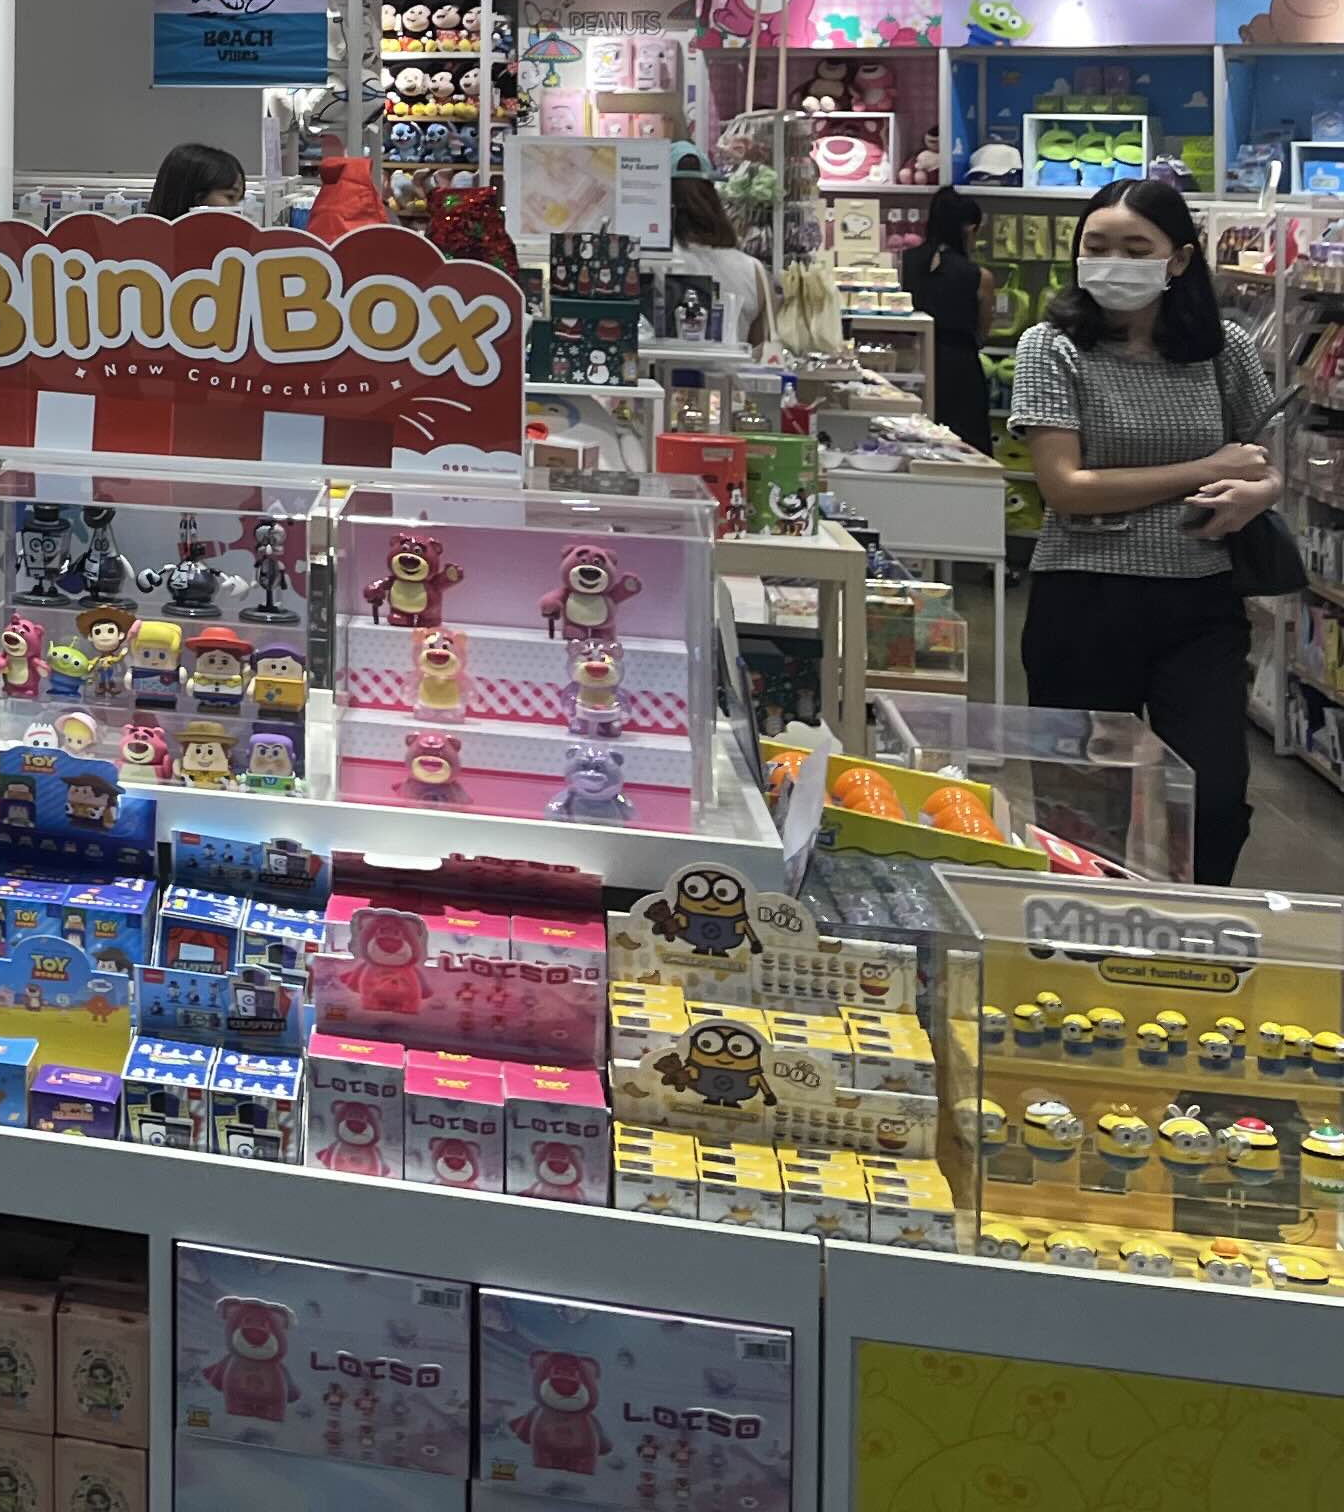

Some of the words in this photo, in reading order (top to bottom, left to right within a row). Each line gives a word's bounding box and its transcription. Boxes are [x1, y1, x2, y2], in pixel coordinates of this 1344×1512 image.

[568, 10, 663, 36] PEANUTS
[103, 362, 165, 378] New
[187, 367, 372, 396] Collection
[1026, 899, 1258, 970] Minions
[441, 954, 570, 985] LOTSO
[1106, 963, 1147, 977] vocal
[313, 1074, 398, 1099] LOTSO
[410, 1110, 497, 1136] LOTSO
[512, 1114, 601, 1139] LOTSO
[309, 1351, 442, 1389] LOTSO
[622, 1402, 762, 1440] LOTSO
